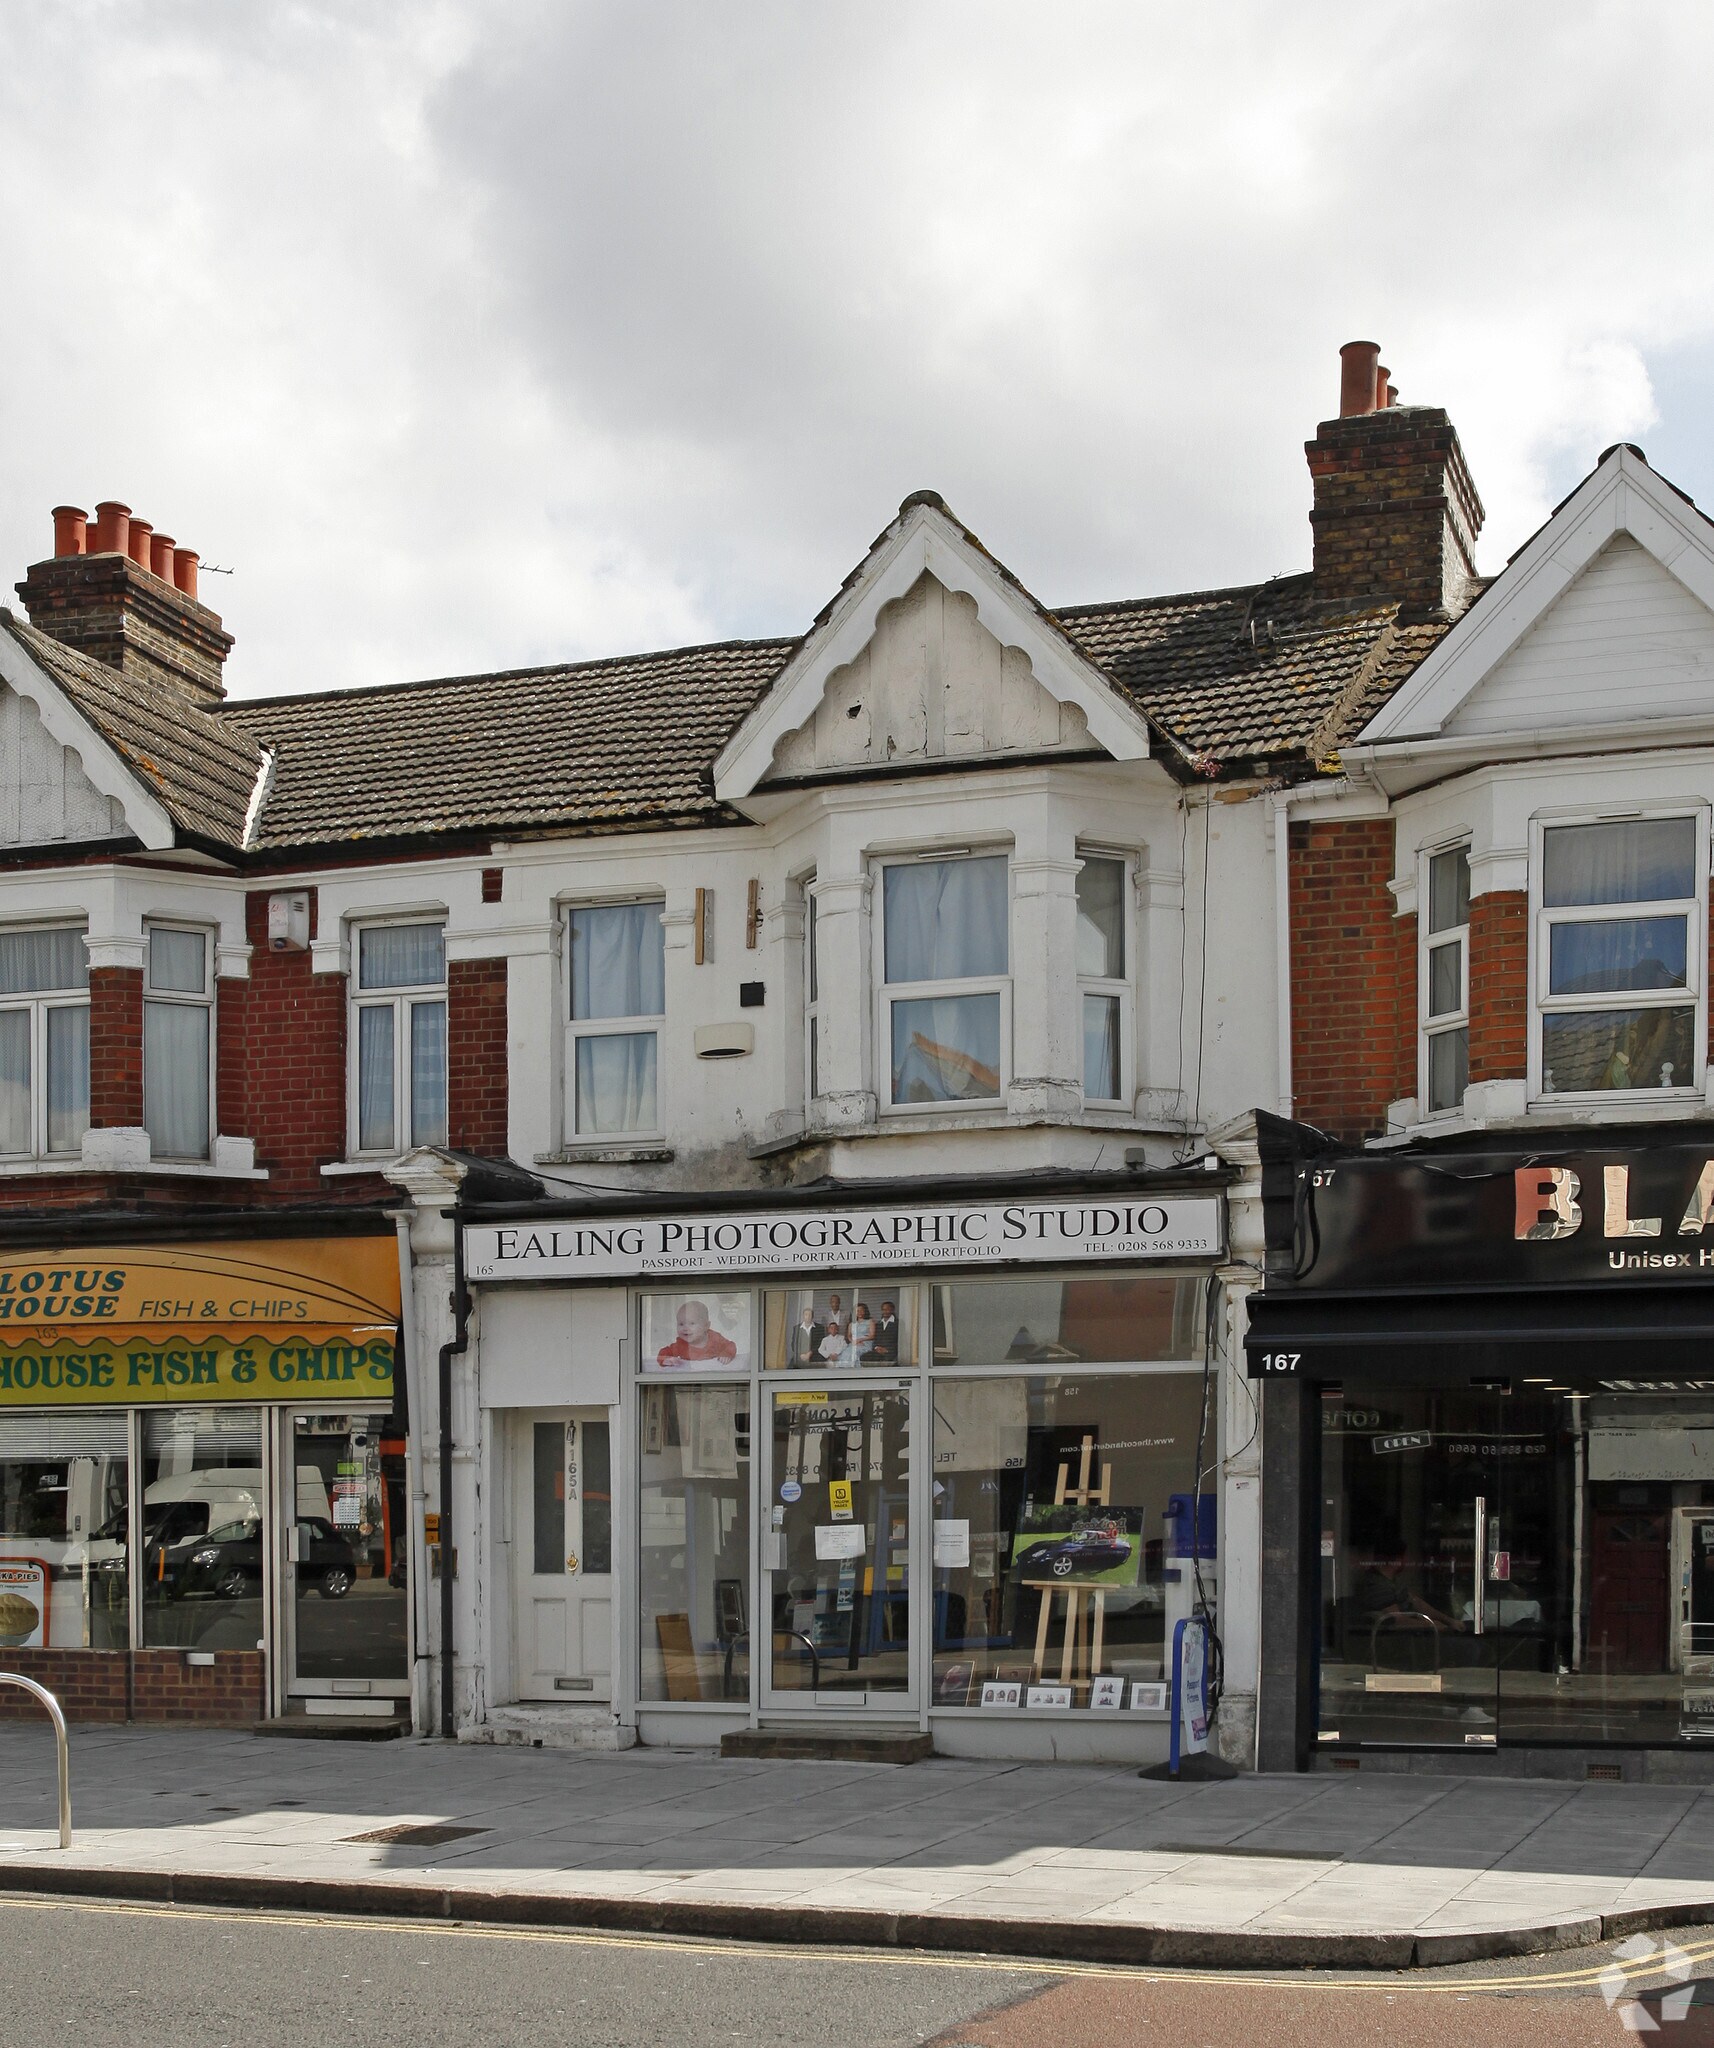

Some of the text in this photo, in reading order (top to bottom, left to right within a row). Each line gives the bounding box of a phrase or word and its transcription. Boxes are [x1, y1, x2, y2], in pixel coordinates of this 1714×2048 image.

[494, 1206, 1169, 1260] EALING PHOTOGRAPHIC STUDIO
[1083, 1239, 1207, 1252] TEL: 0208 568 9333
[641, 1257, 705, 1268] PASSPORT
[716, 1254, 781, 1265] WEDDING
[792, 1250, 859, 1263] PORTRAIT
[870, 1249, 920, 1260] MODEL
[923, 1245, 1001, 1258] PORTFOLIO
[1609, 1251, 1691, 1269] Unisex
[475, 1265, 494, 1275] 165
[0, 1270, 126, 1294] LOTUS
[139, 1300, 308, 1318] FISH & CHIPS
[127, 1350, 219, 1386] FISH
[231, 1348, 257, 1382] &
[269, 1345, 394, 1382] CHIPS
[1262, 1353, 1301, 1371] 167
